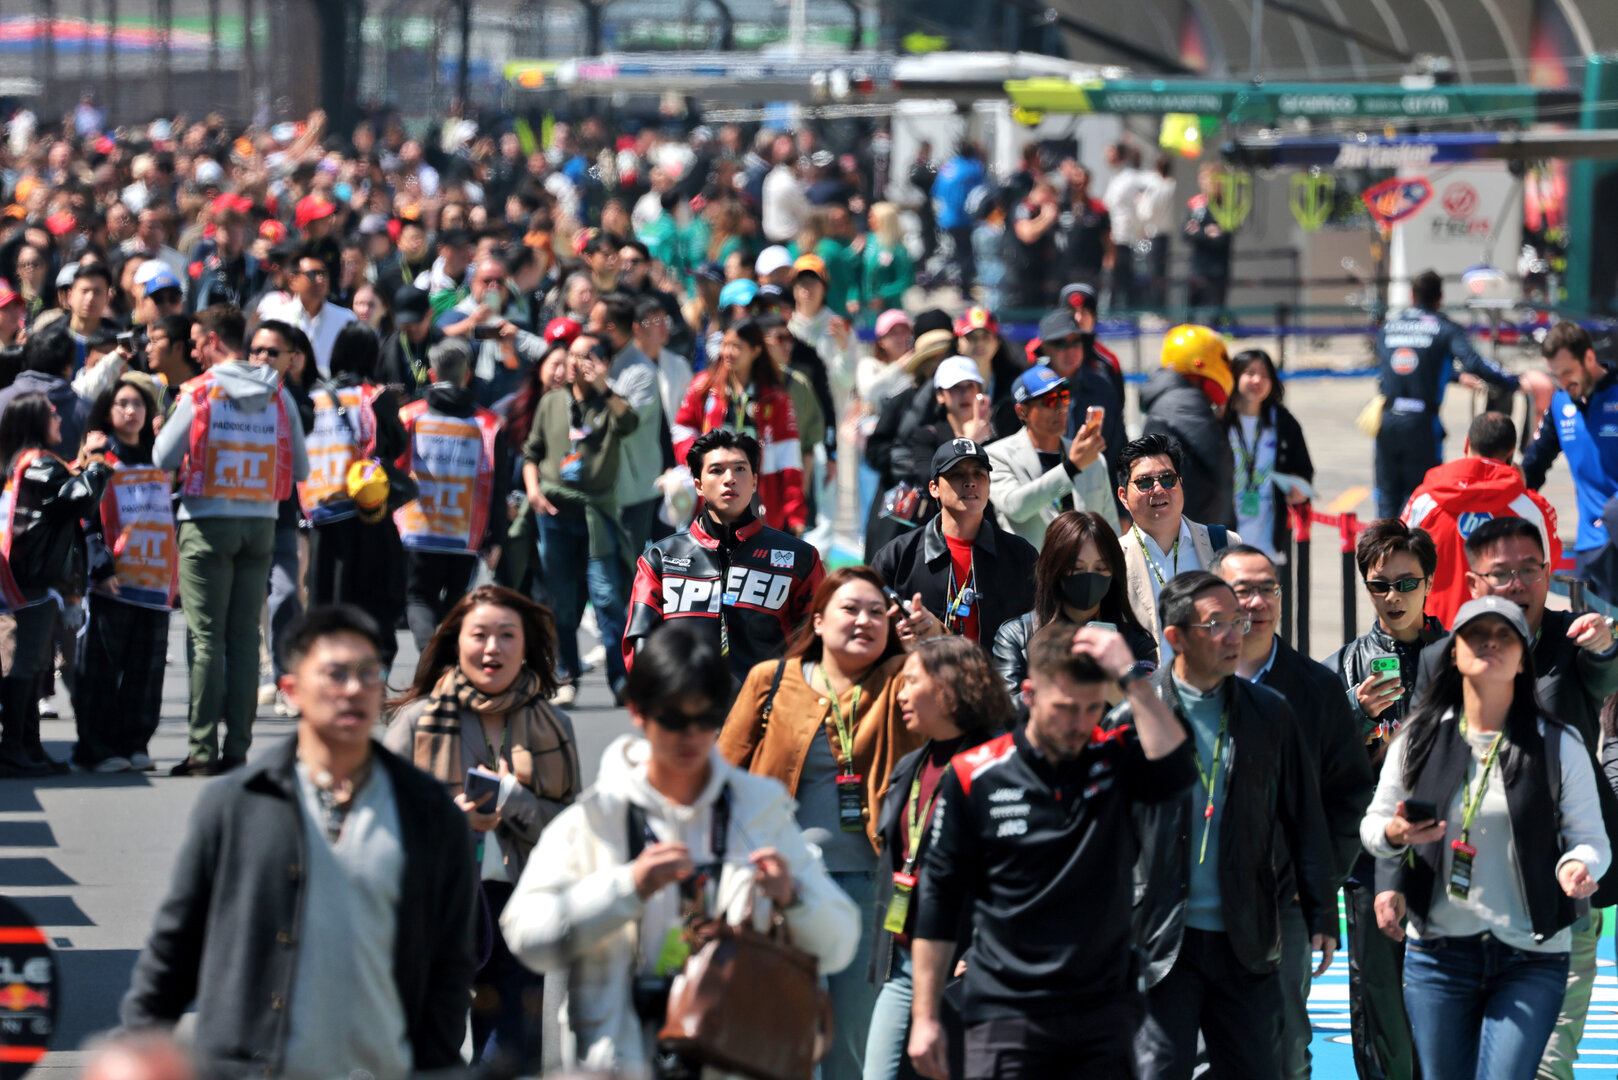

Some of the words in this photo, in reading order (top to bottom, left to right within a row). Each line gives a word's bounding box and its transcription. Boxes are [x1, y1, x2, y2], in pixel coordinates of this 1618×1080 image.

[253, 424, 275, 433] CLUB
[214, 449, 268, 477] PIT
[124, 529, 168, 557] PIT
[662, 566, 793, 614] SPEED
